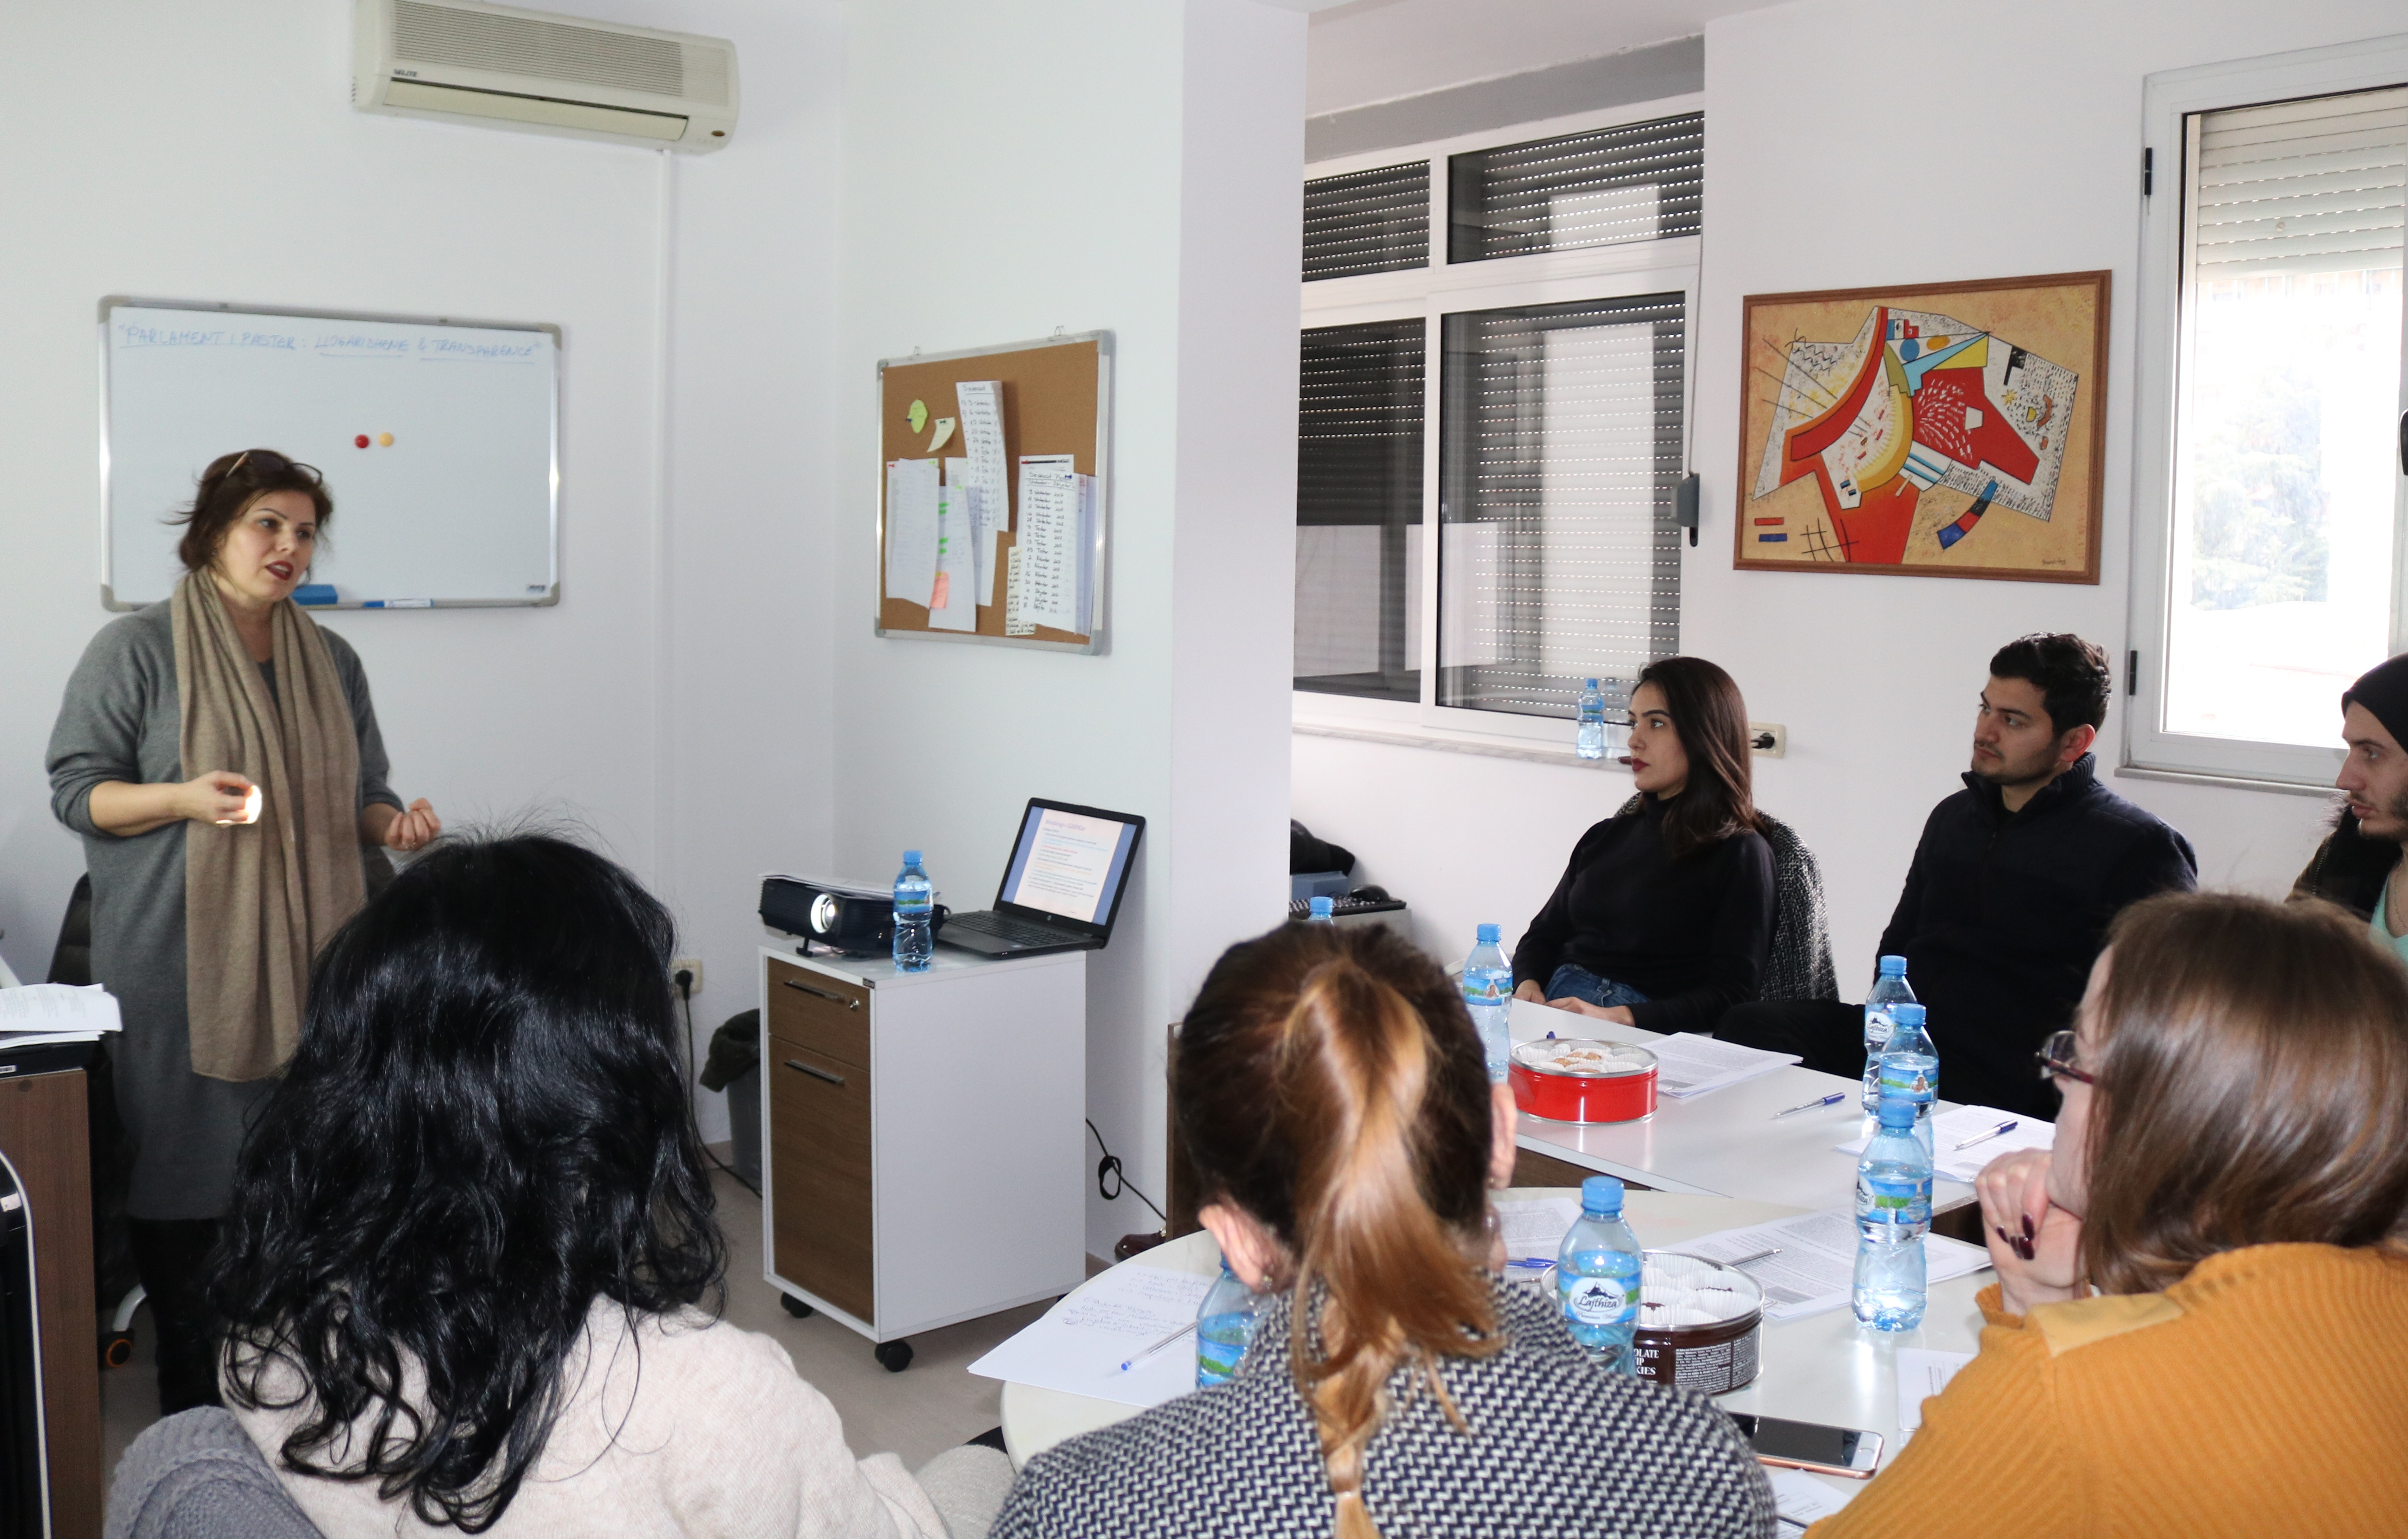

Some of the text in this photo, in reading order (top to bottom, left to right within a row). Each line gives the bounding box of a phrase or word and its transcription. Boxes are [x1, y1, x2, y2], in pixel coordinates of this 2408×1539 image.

[1579, 1295, 1618, 1312] Lajthiza
[1634, 1348, 1660, 1359] OLATE
[1636, 1357, 1645, 1366] IP
[1637, 1366, 1656, 1376] KIES
